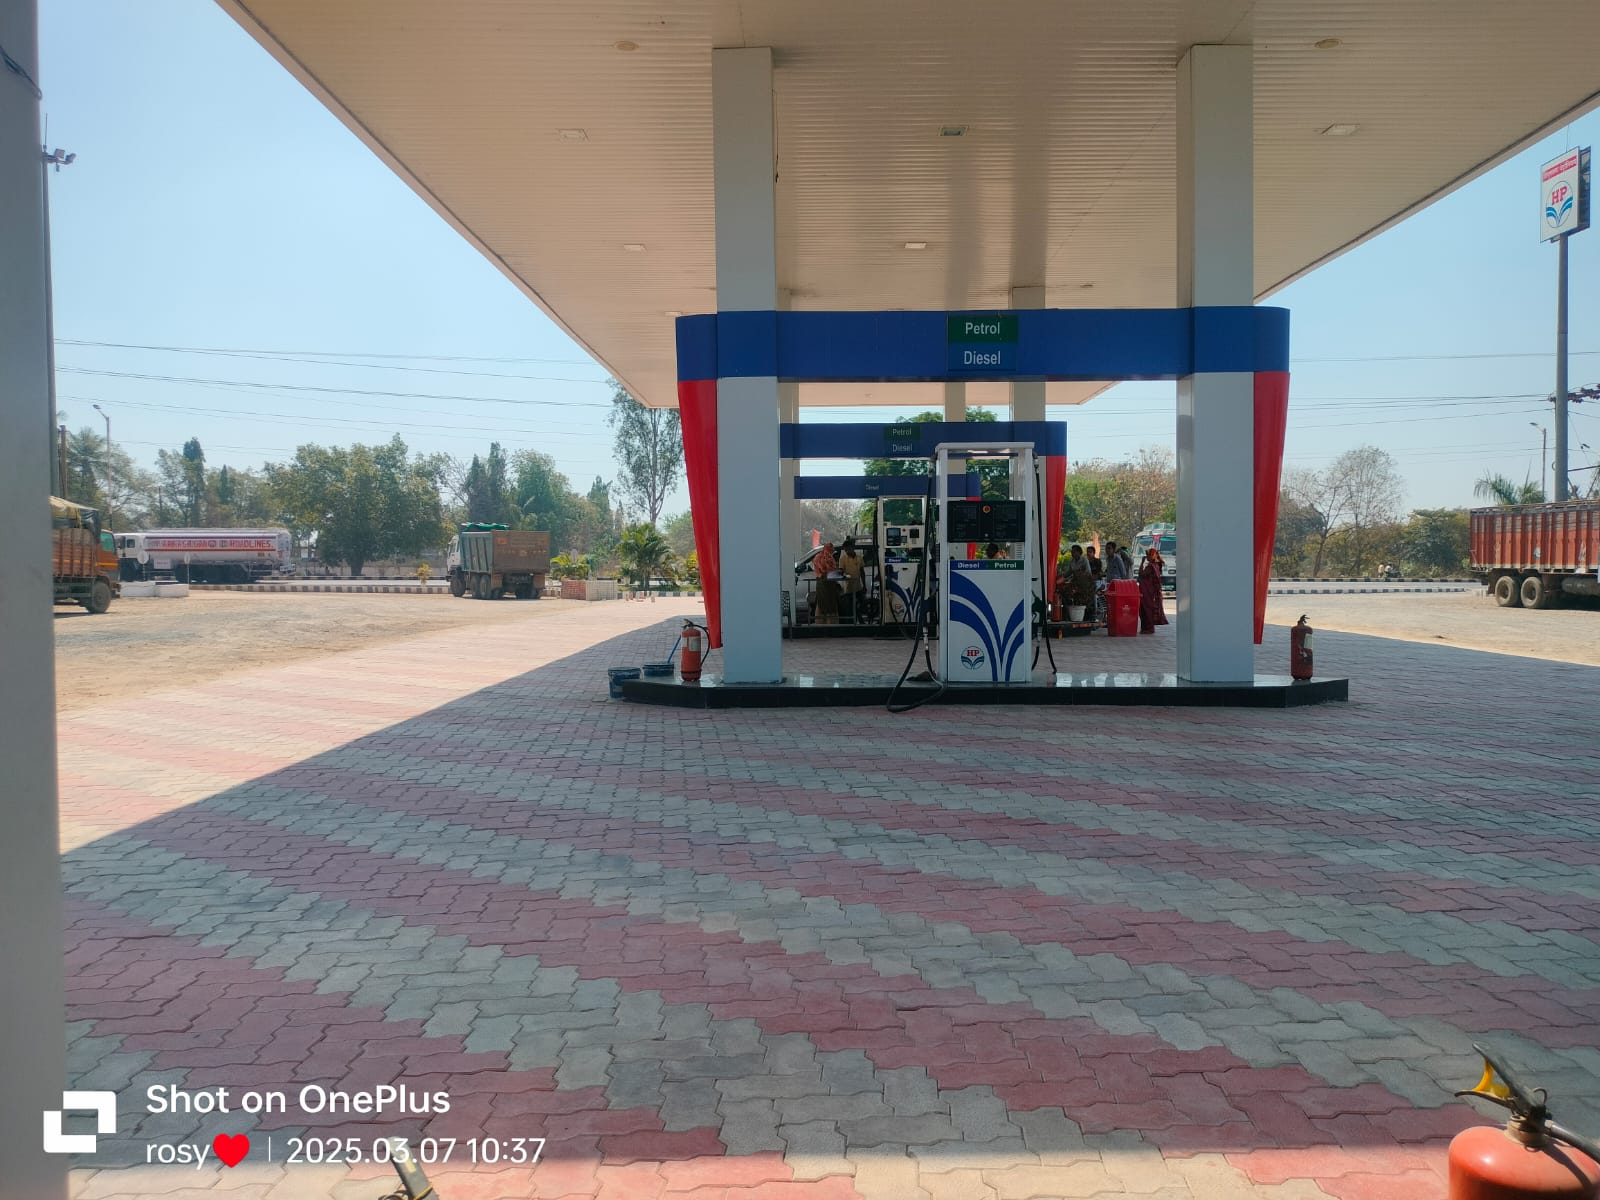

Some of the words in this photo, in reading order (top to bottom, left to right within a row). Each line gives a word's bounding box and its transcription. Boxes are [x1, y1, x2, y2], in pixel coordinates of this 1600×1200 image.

[1551, 186, 1568, 206] HP
[965, 322, 1001, 335] Petrol
[963, 350, 1001, 365] Diesel
[892, 427, 912, 436] Petrol
[892, 443, 913, 452] Diesel
[966, 649, 980, 657] HP
